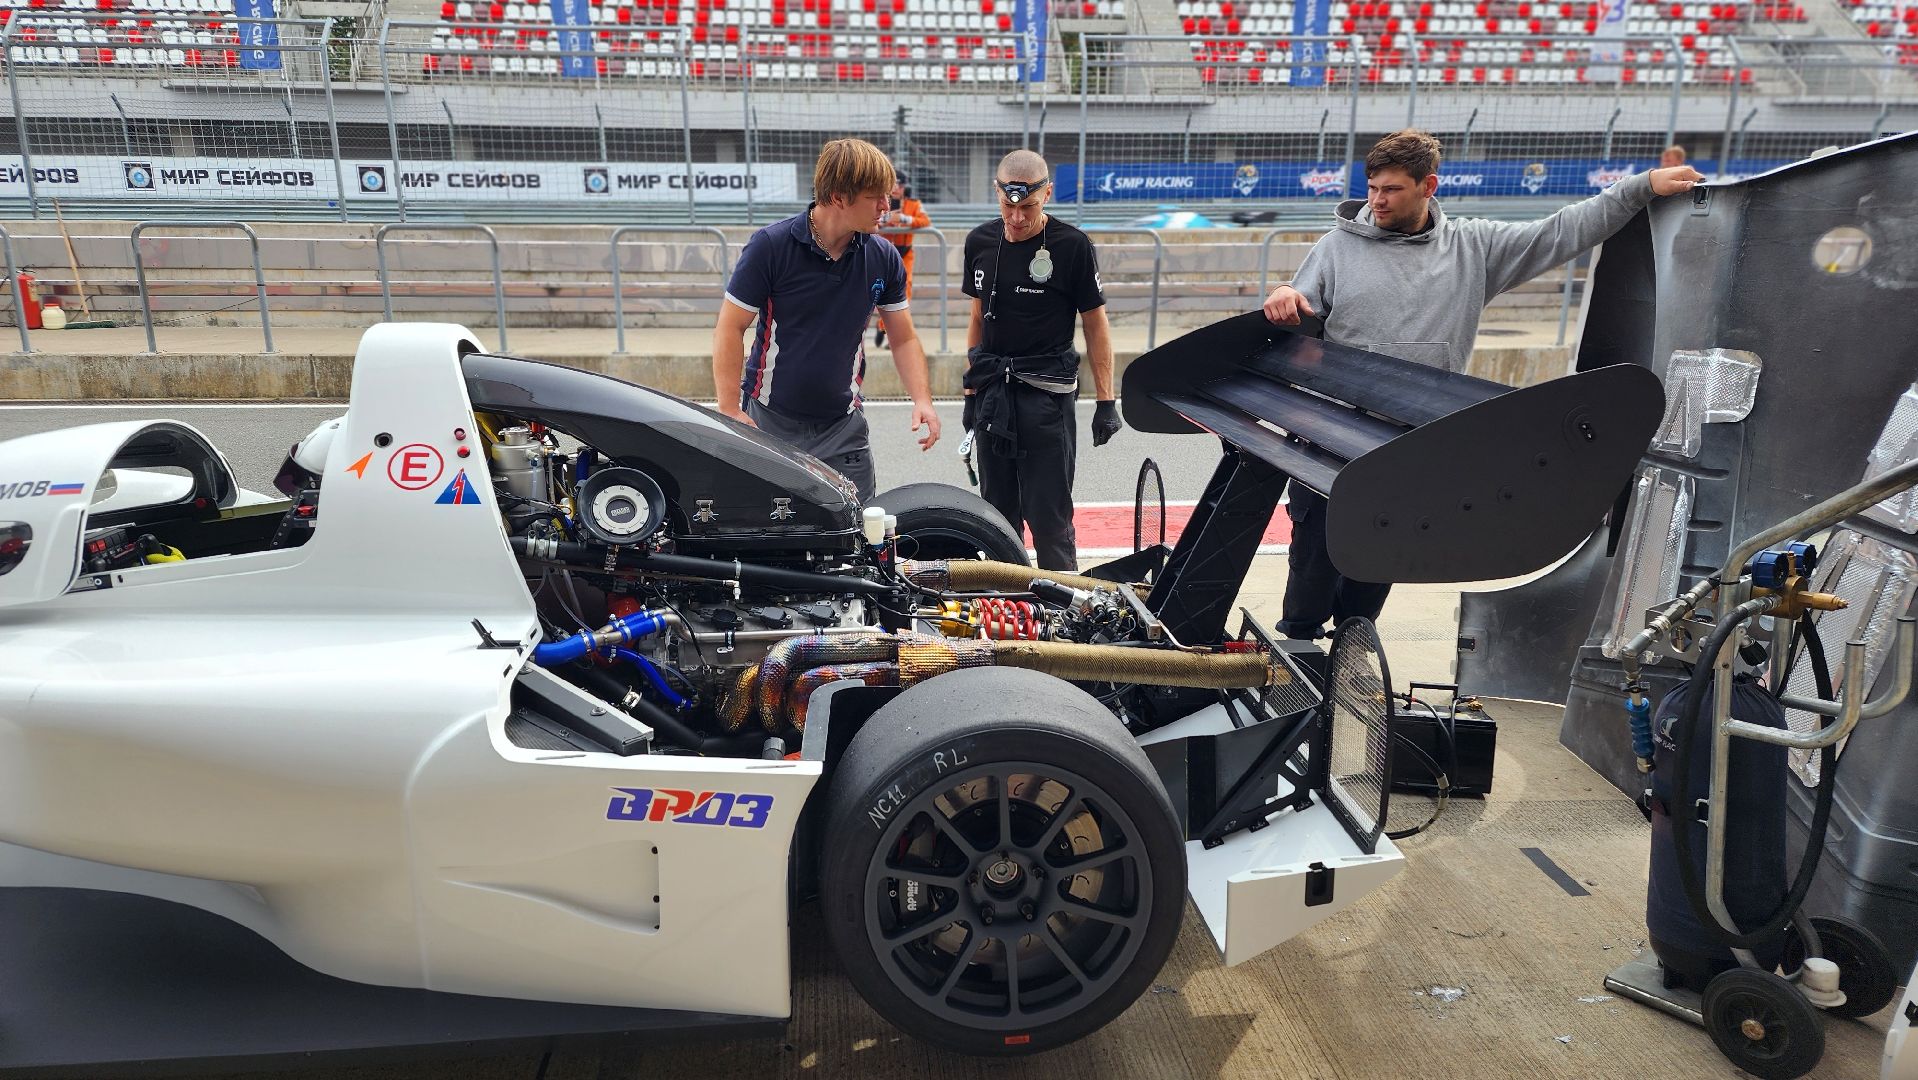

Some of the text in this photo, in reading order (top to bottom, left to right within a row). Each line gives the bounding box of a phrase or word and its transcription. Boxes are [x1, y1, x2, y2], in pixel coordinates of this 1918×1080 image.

[160, 166, 315, 187] МИР СЕЙФОВ
[446, 169, 541, 188] СЕЙФОВ
[617, 174, 662, 189] МИР
[1114, 176, 1194, 189] SMP RACING
[1437, 174, 1483, 187] RACING
[401, 452, 430, 482] E
[868, 784, 907, 829] NC11
